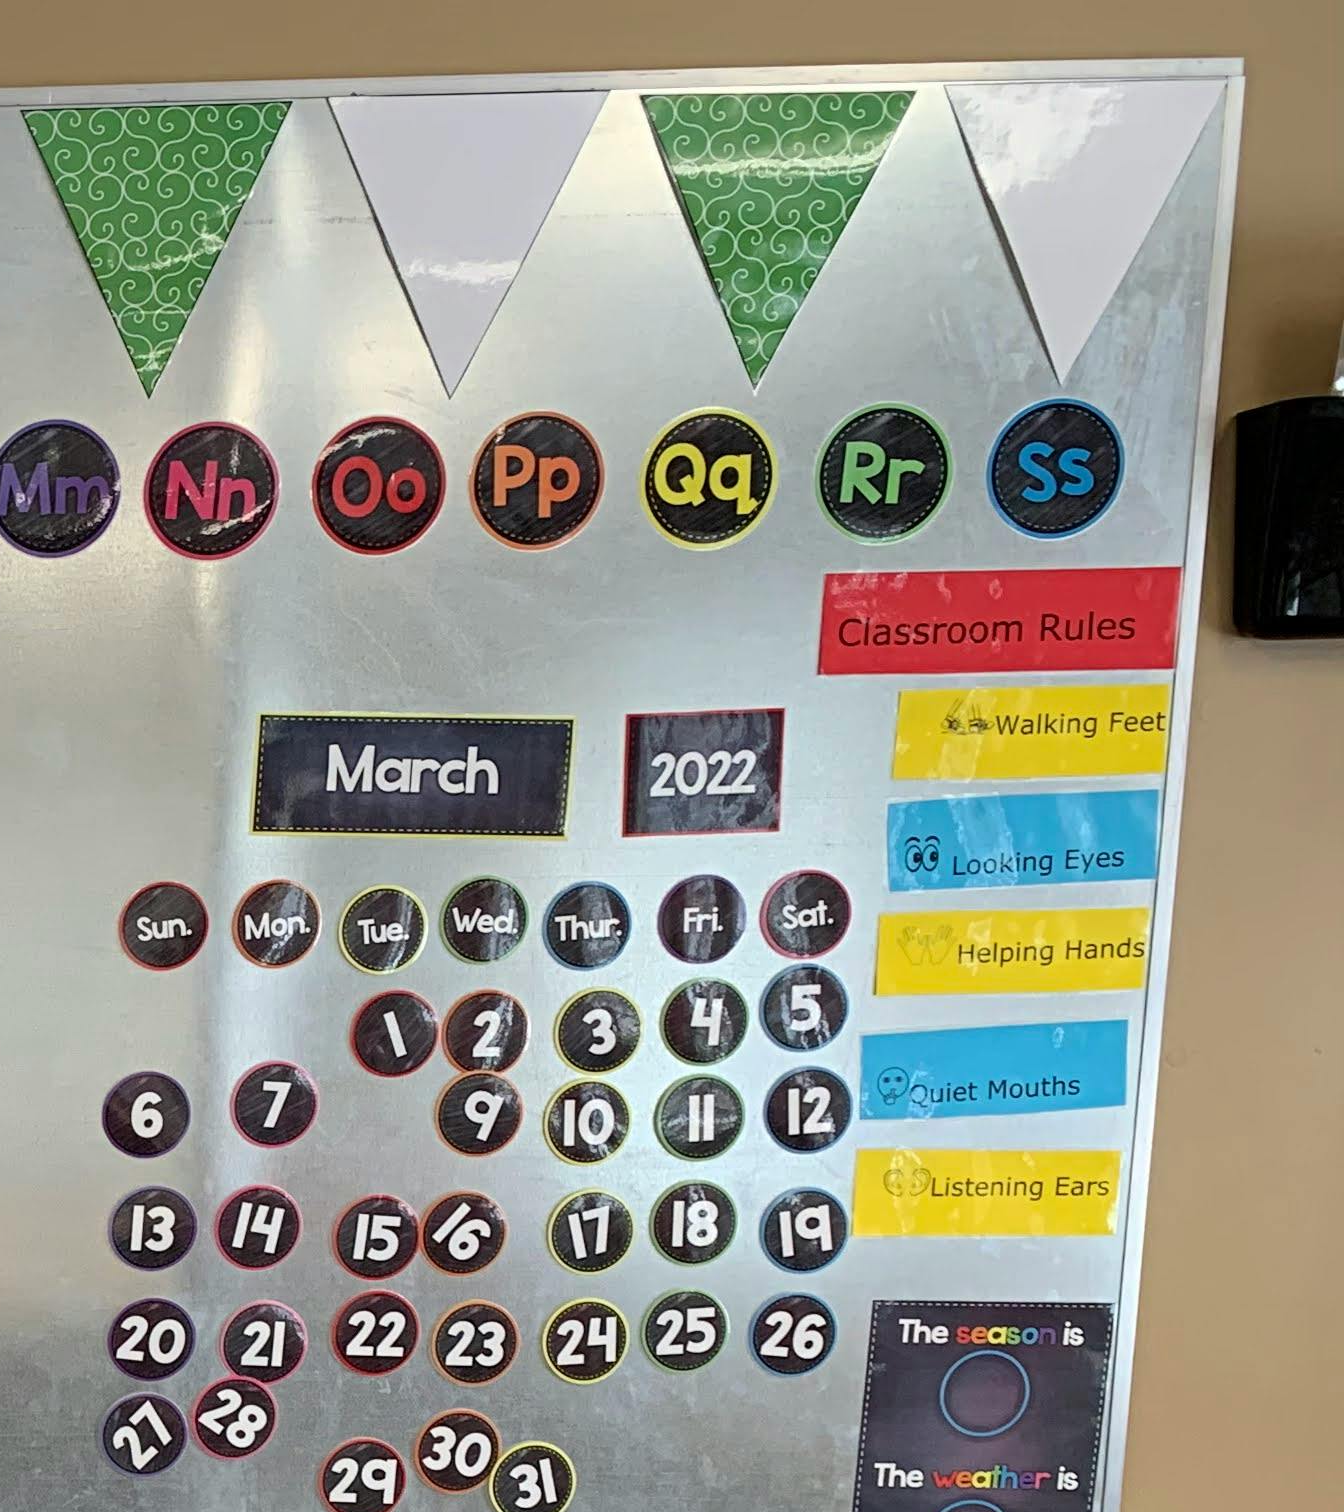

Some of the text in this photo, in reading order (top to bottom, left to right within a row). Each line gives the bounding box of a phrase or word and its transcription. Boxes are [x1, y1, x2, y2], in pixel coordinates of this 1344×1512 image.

[165, 460, 256, 522] Nn
[331, 455, 426, 518] Oo
[494, 445, 580, 518] Pp
[655, 442, 760, 515] Qq
[839, 441, 925, 505] Rr
[1018, 441, 1095, 503] Ss
[839, 611, 1136, 646] Classroom Rules
[996, 712, 1166, 738] Walking Feet
[326, 744, 499, 794] March
[649, 750, 757, 797] 2022
[953, 849, 1125, 876] Looking Eyes
[136, 917, 193, 942] Sun.
[244, 912, 311, 940] Mon.
[357, 918, 410, 945] Tue.
[452, 907, 518, 934] Wed.
[554, 915, 622, 942] Thur.
[683, 907, 723, 933] Fri.
[782, 900, 834, 930] Sat.
[958, 938, 1145, 967] Helping Hands
[582, 1008, 617, 1055] 3
[690, 998, 723, 1046] 4
[790, 984, 821, 1032] 5
[383, 1011, 408, 1058] 1
[472, 1010, 500, 1058] 2
[130, 1092, 163, 1138] 6
[262, 1081, 291, 1128] 7
[464, 1090, 504, 1142] 9
[787, 1087, 832, 1136] 12
[909, 1076, 1080, 1108] Quiet Mouths
[563, 1099, 613, 1147] 10
[688, 1094, 714, 1142] 11
[931, 1177, 1110, 1201] Listening Ears
[130, 1205, 176, 1252] 13
[232, 1202, 285, 1254] 14
[353, 1213, 401, 1261] 15
[432, 1202, 492, 1260] 16
[567, 1205, 610, 1260] 17
[671, 1200, 718, 1247] 18
[779, 1204, 833, 1258] 19
[115, 1315, 186, 1364] 20
[240, 1321, 286, 1367] 21
[346, 1311, 406, 1358] 22
[445, 1321, 506, 1367] 23
[556, 1316, 616, 1365] 24
[655, 1307, 716, 1356] 25
[760, 1310, 827, 1359] 26
[899, 1319, 1085, 1346] The season is
[113, 1400, 173, 1470] 27
[198, 1388, 268, 1448] 28
[422, 1426, 492, 1477] 30
[328, 1458, 398, 1505] 29
[509, 1458, 558, 1509] 31
[874, 1462, 1079, 1491] The weather is
